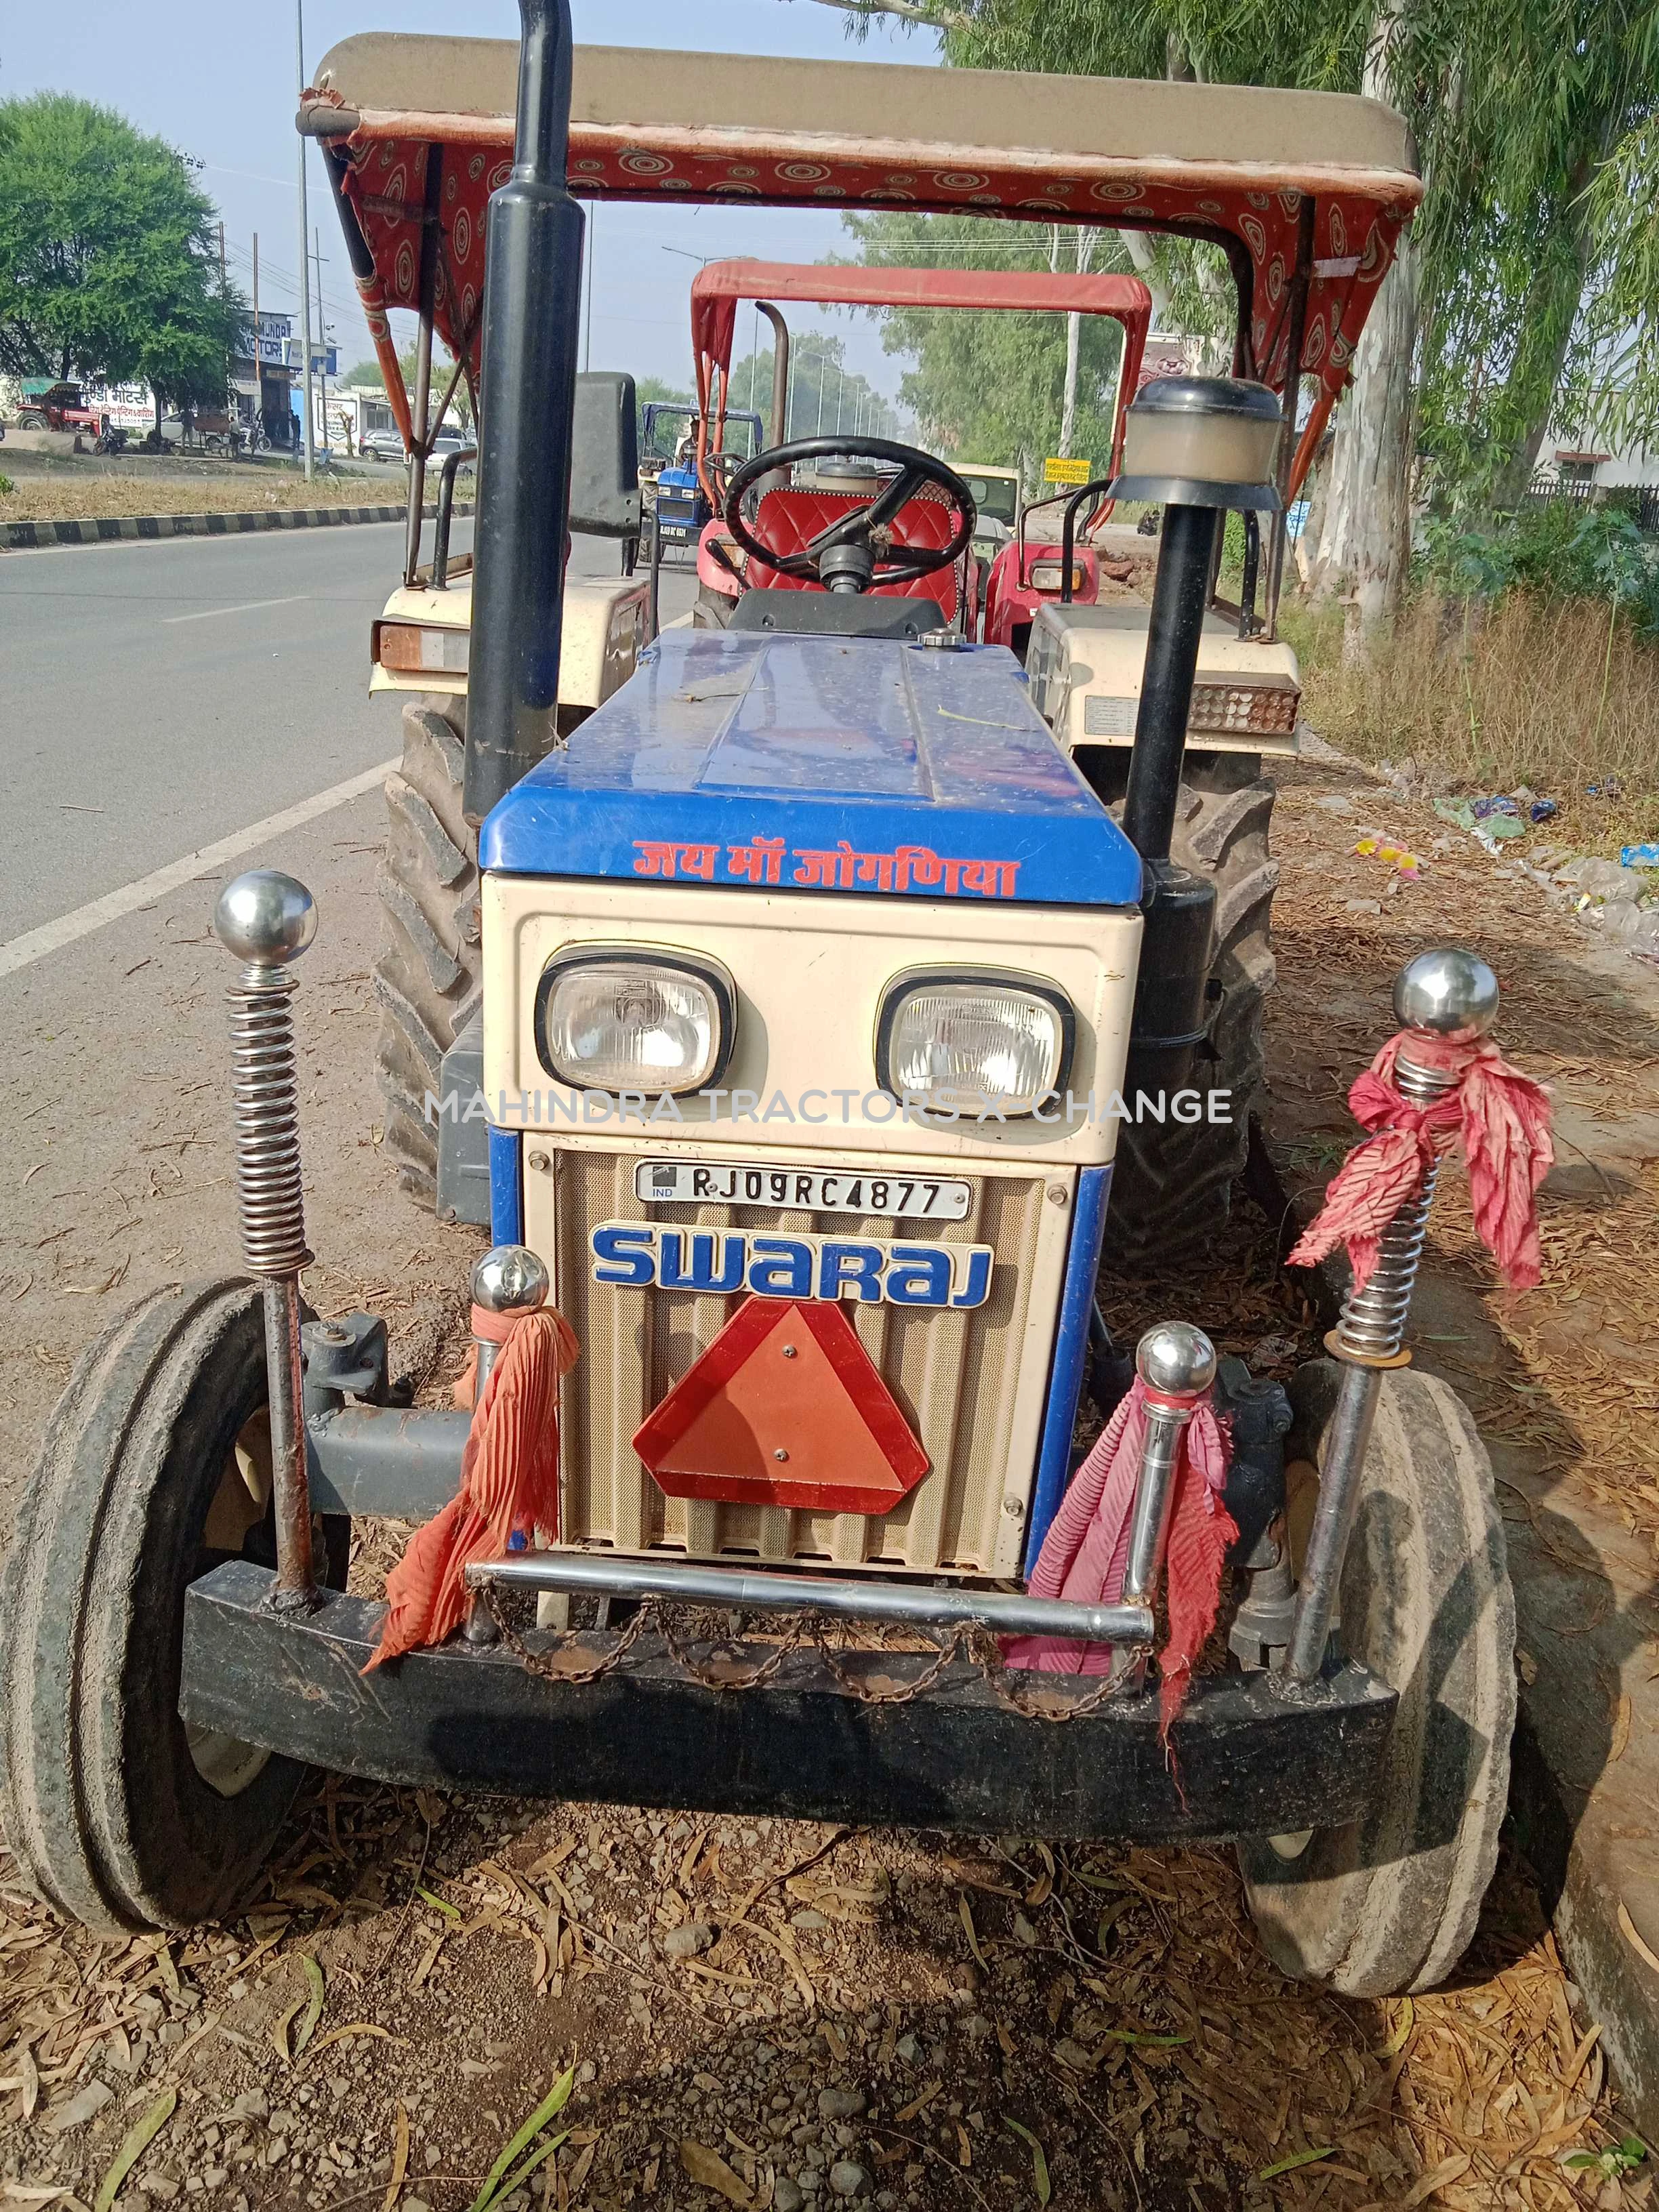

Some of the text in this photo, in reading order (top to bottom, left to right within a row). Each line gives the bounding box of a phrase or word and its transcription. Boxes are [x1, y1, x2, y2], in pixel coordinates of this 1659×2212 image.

[633, 840, 720, 879] जय
[792, 840, 1021, 897] जोगणिया
[653, 1187, 673, 1197] IND
[693, 1168, 940, 1214] RJ09RC4877
